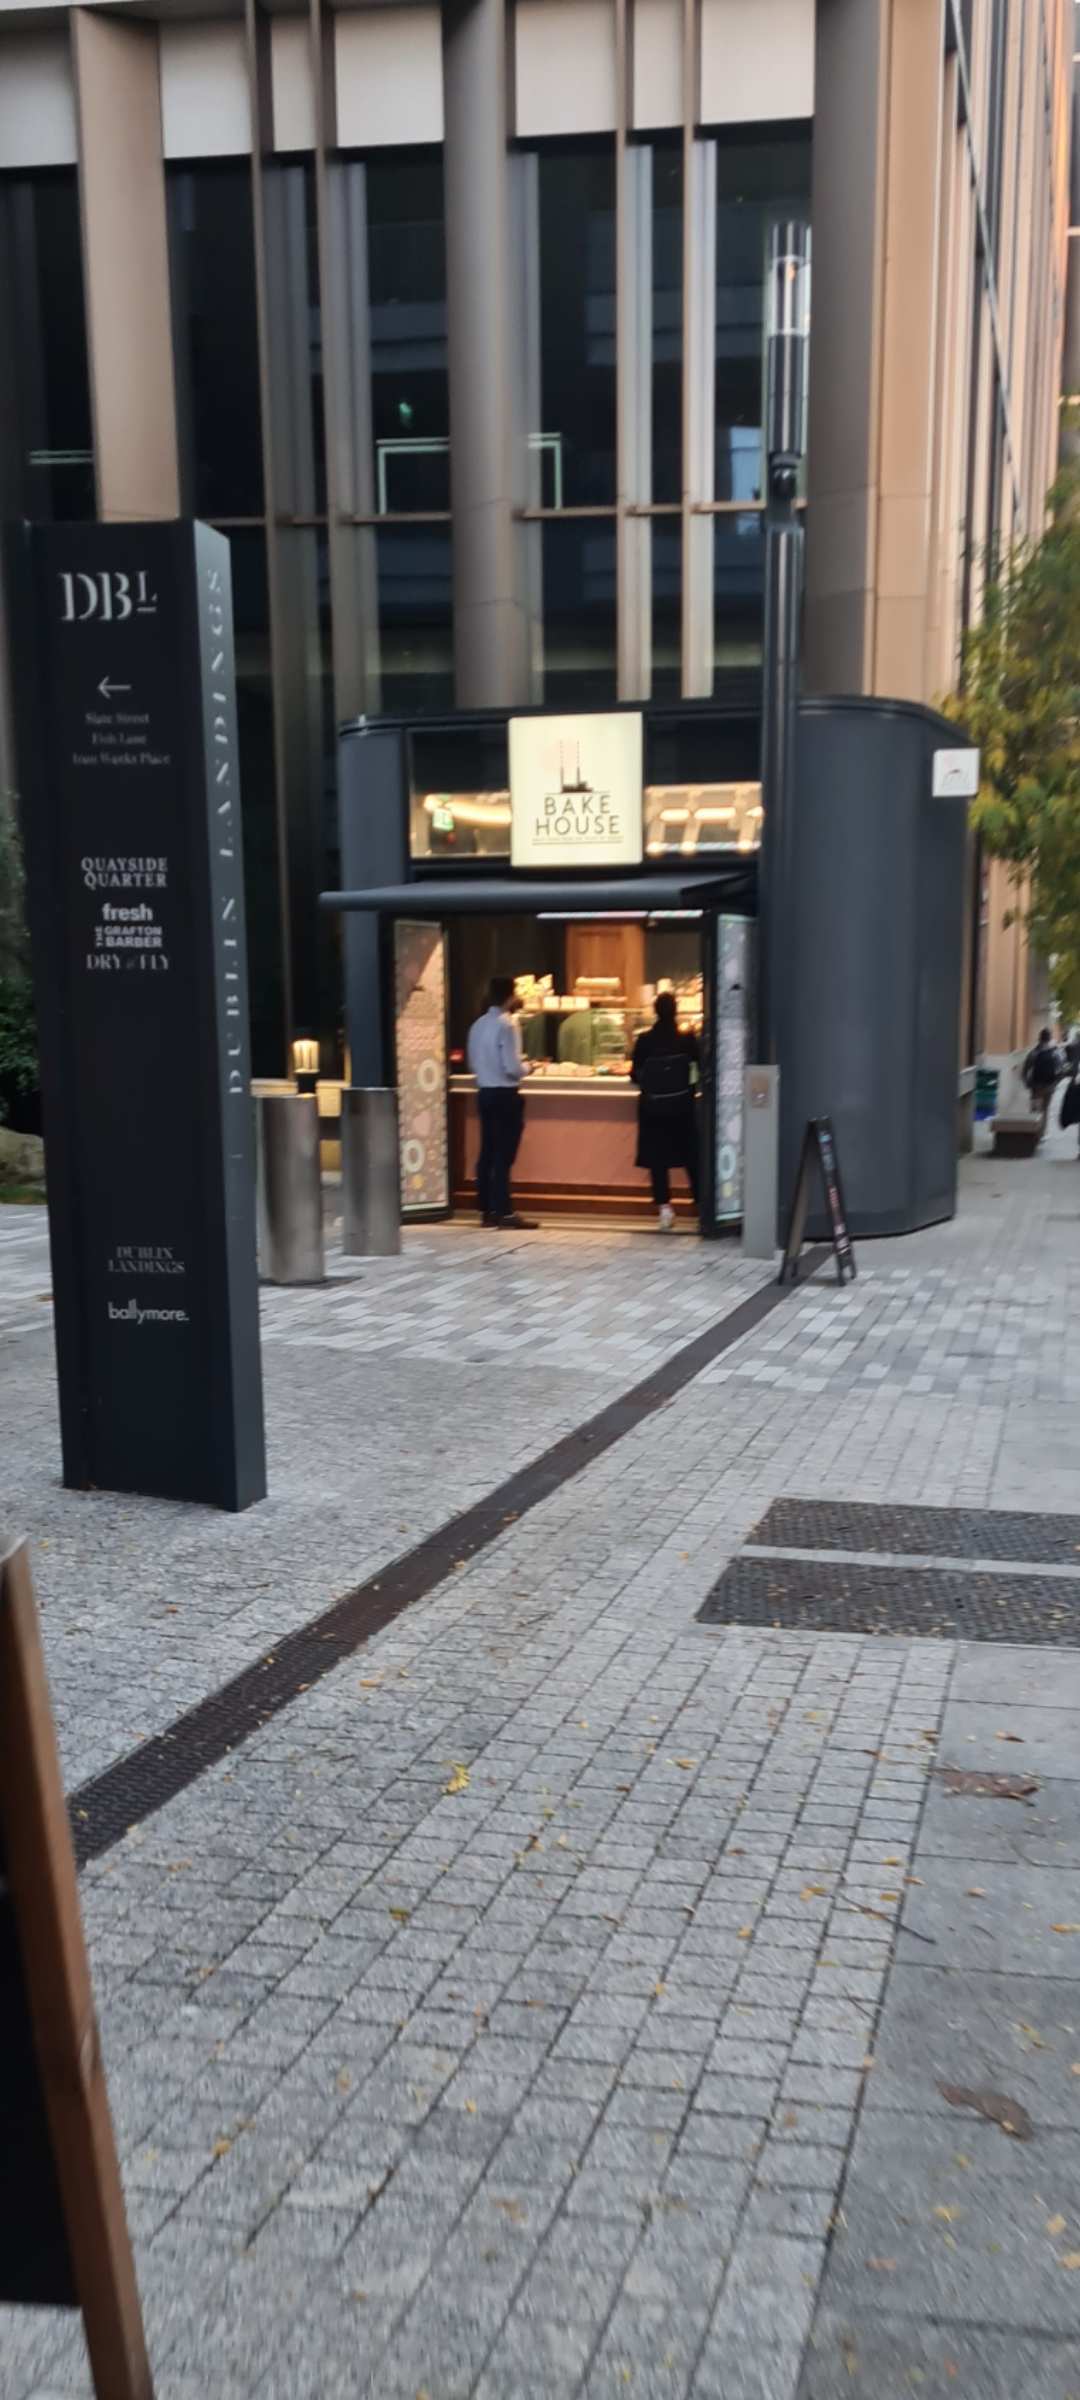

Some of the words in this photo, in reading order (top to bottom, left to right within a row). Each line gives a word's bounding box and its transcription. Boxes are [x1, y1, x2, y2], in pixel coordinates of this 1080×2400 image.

[206, 569, 234, 857] LANDINGS
[543, 794, 610, 816] BAKE
[535, 815, 620, 836] HOUSE
[81, 857, 168, 872] QUAYSIDE
[84, 871, 167, 890] QUARTER
[102, 902, 153, 921] fresh
[104, 925, 162, 936] GRAFTON
[105, 936, 162, 947] BARBER
[86, 954, 121, 970] DRY
[221, 897, 244, 1093] DUBLIN
[116, 1246, 173, 1259] DUBLIN
[108, 1260, 185, 1273] LANDINGS
